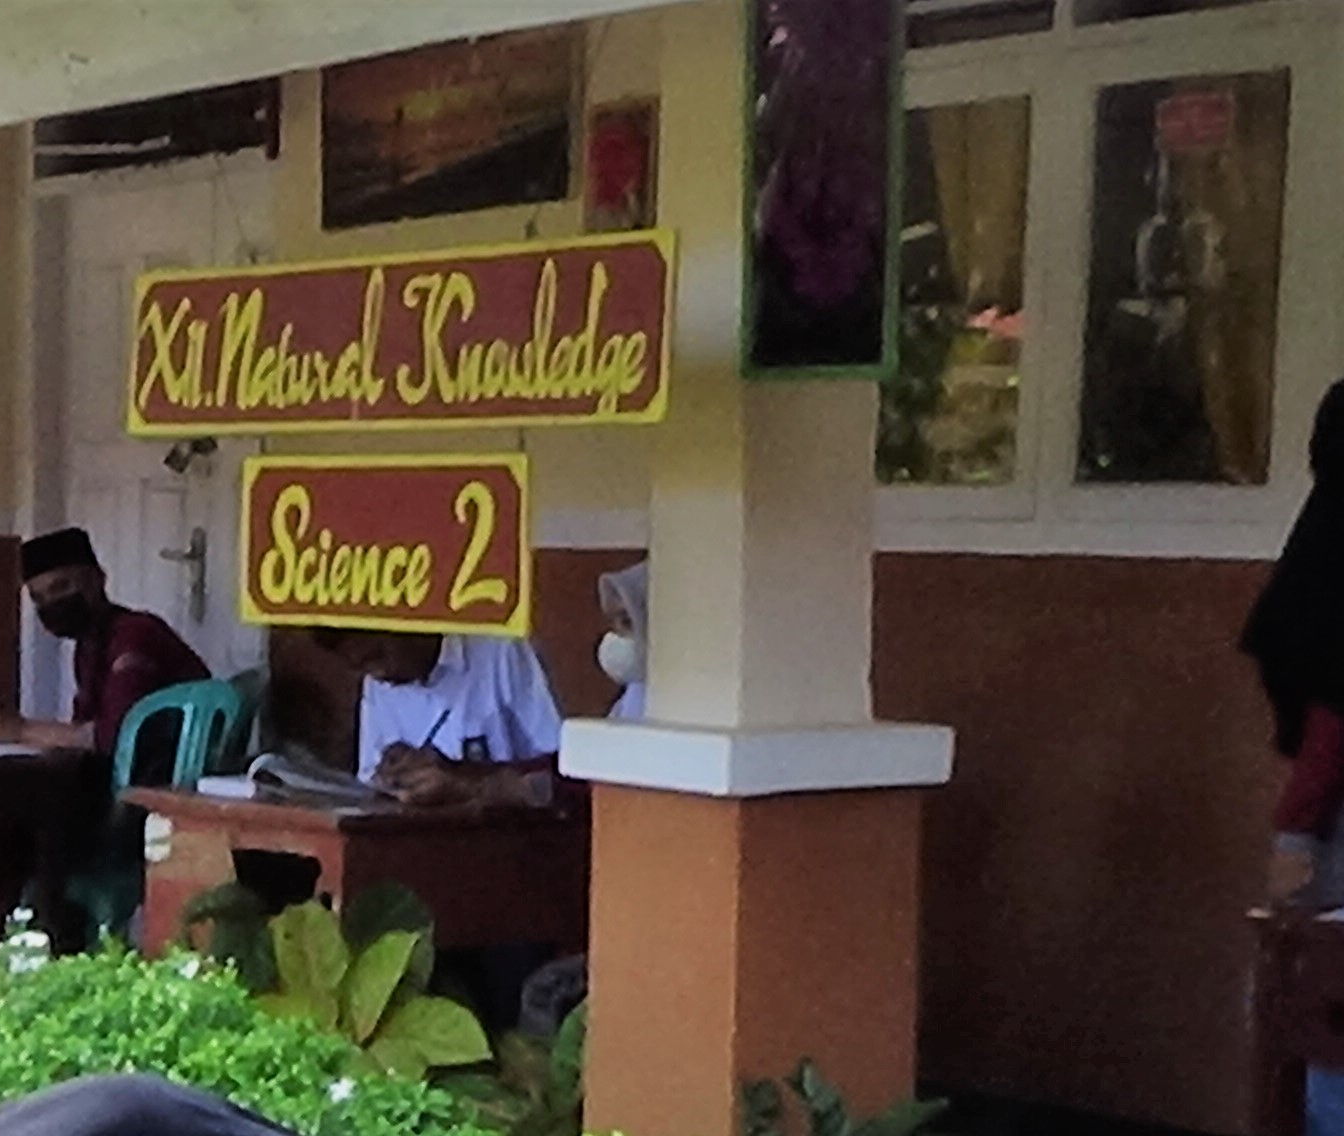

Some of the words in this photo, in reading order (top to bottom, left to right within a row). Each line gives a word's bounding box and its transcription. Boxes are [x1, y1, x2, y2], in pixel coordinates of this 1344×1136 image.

[396, 257, 648, 416] Knowledge
[259, 484, 431, 607] Science
[449, 480, 508, 612] 2
